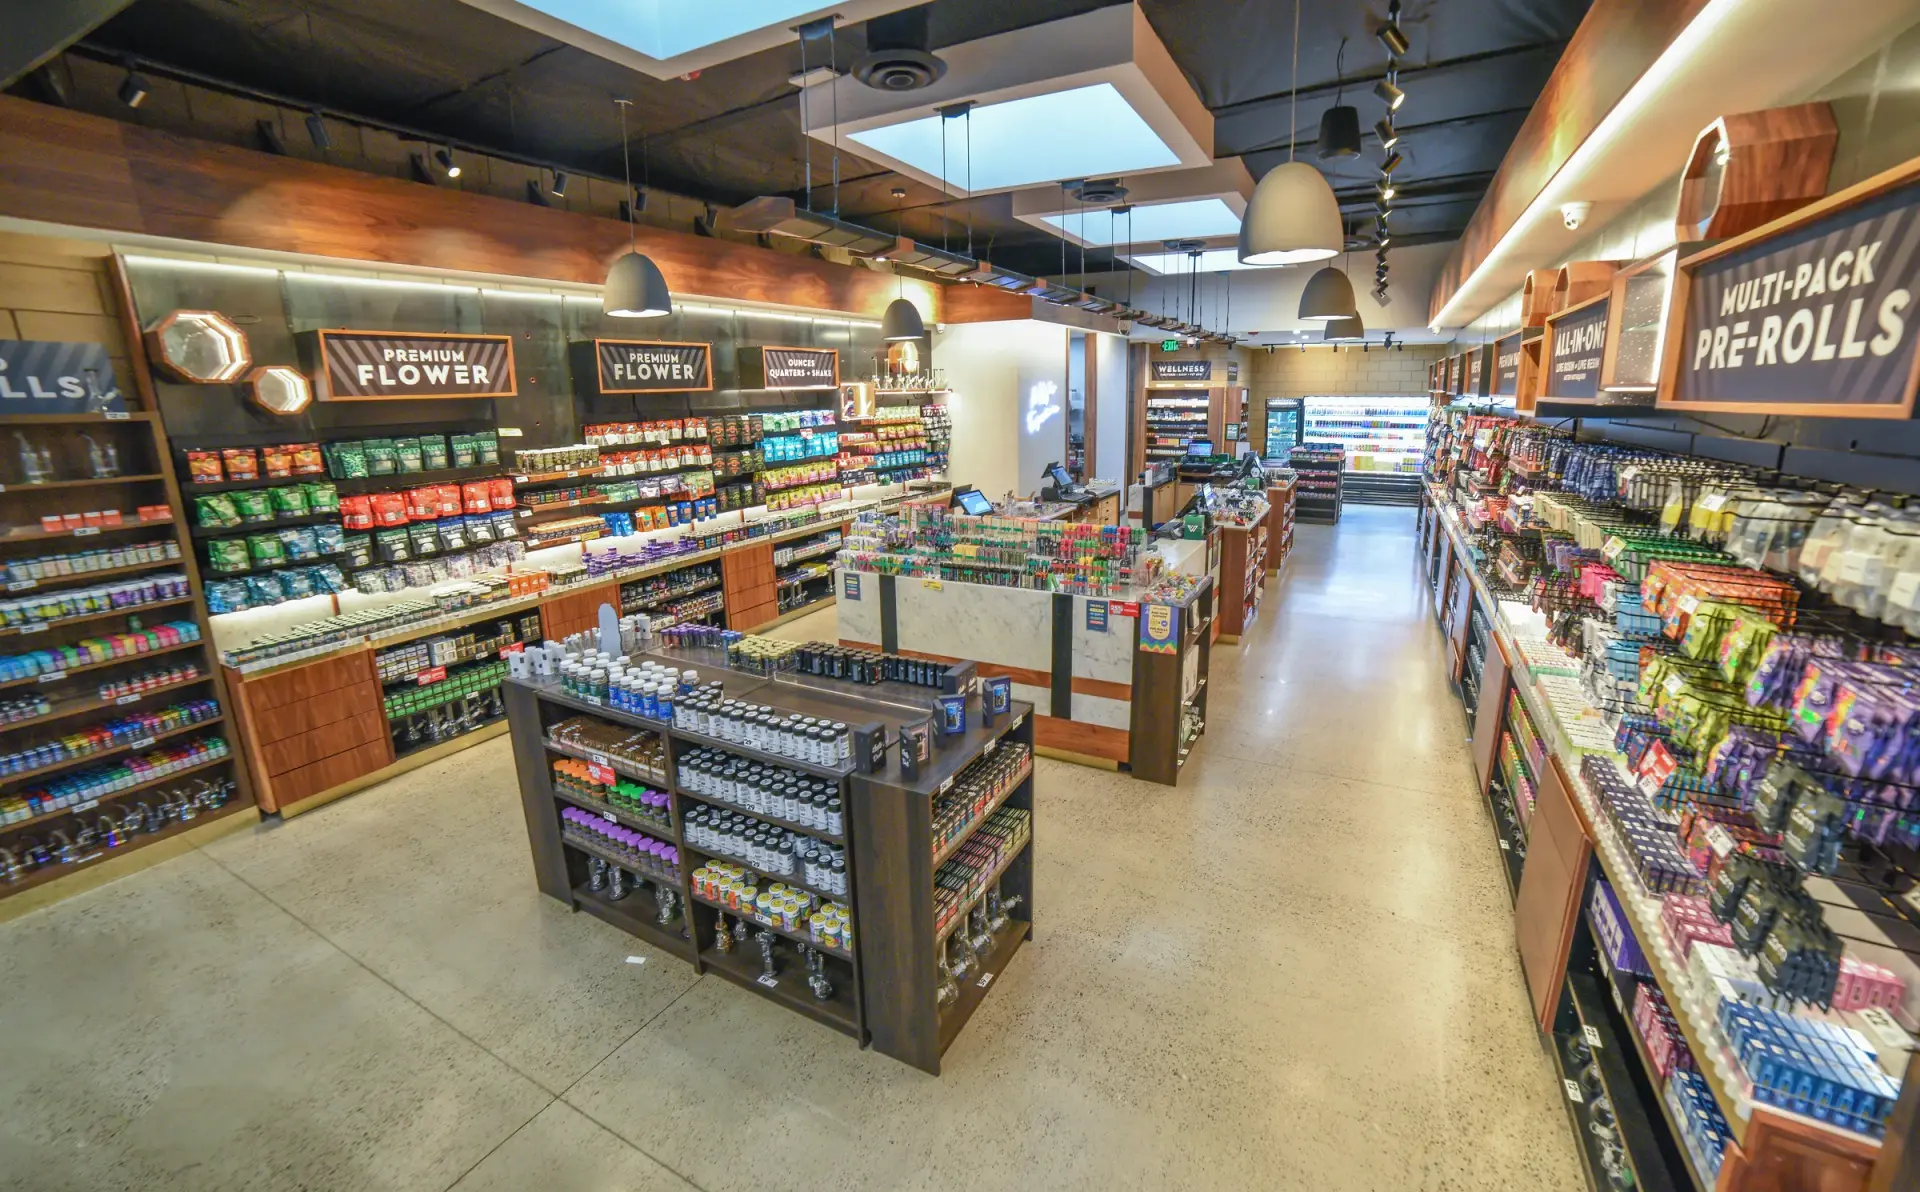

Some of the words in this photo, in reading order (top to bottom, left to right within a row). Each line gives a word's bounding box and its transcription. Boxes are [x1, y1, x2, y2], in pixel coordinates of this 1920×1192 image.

[1720, 241, 1882, 317] MULTI-PACK
[1693, 289, 1911, 371] PRE-ROLLS
[1164, 340, 1177, 351] EXIT
[384, 349, 464, 362] PREMIUM
[630, 353, 679, 363] PREMIUM
[788, 359, 815, 368] OUNCES
[1158, 365, 1205, 373] WELLNESS
[357, 364, 490, 386] FLOWER
[614, 364, 694, 380] FLOWER
[769, 369, 806, 378] QUARTERS
[811, 369, 832, 377] SHAKE
[1865, 1010, 1890, 1027] 22
